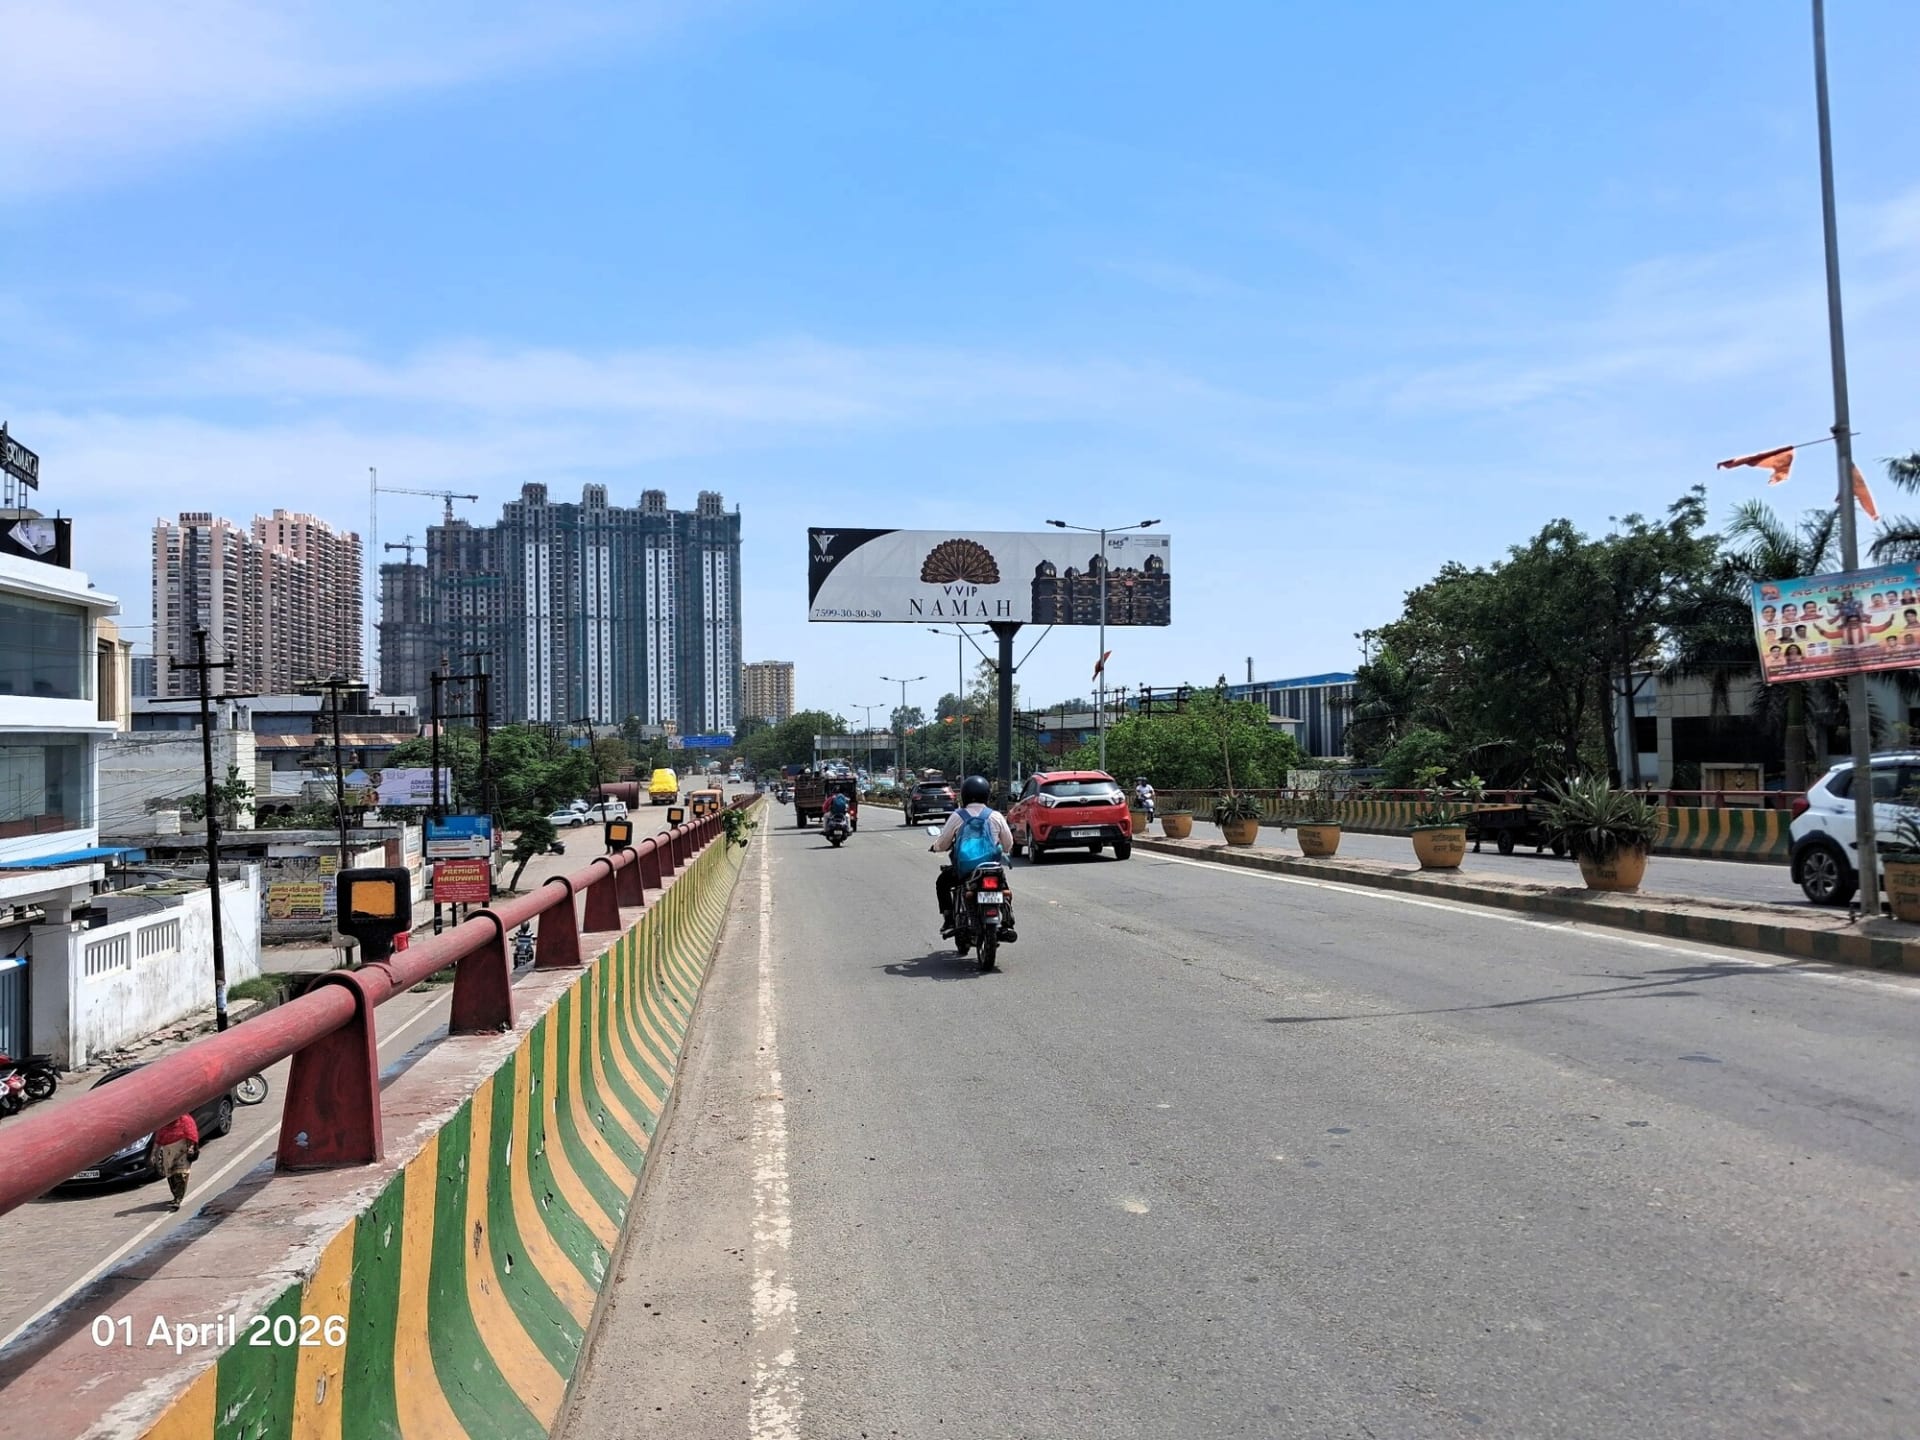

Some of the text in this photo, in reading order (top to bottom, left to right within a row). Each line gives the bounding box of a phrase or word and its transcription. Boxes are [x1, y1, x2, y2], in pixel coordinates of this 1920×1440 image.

[814, 554, 834, 563] VVIP
[943, 585, 978, 597] VVIP
[909, 598, 1011, 617] NAMAH
[815, 608, 882, 618] 7599-30-30-30
[437, 875, 485, 883] HARDWARE
